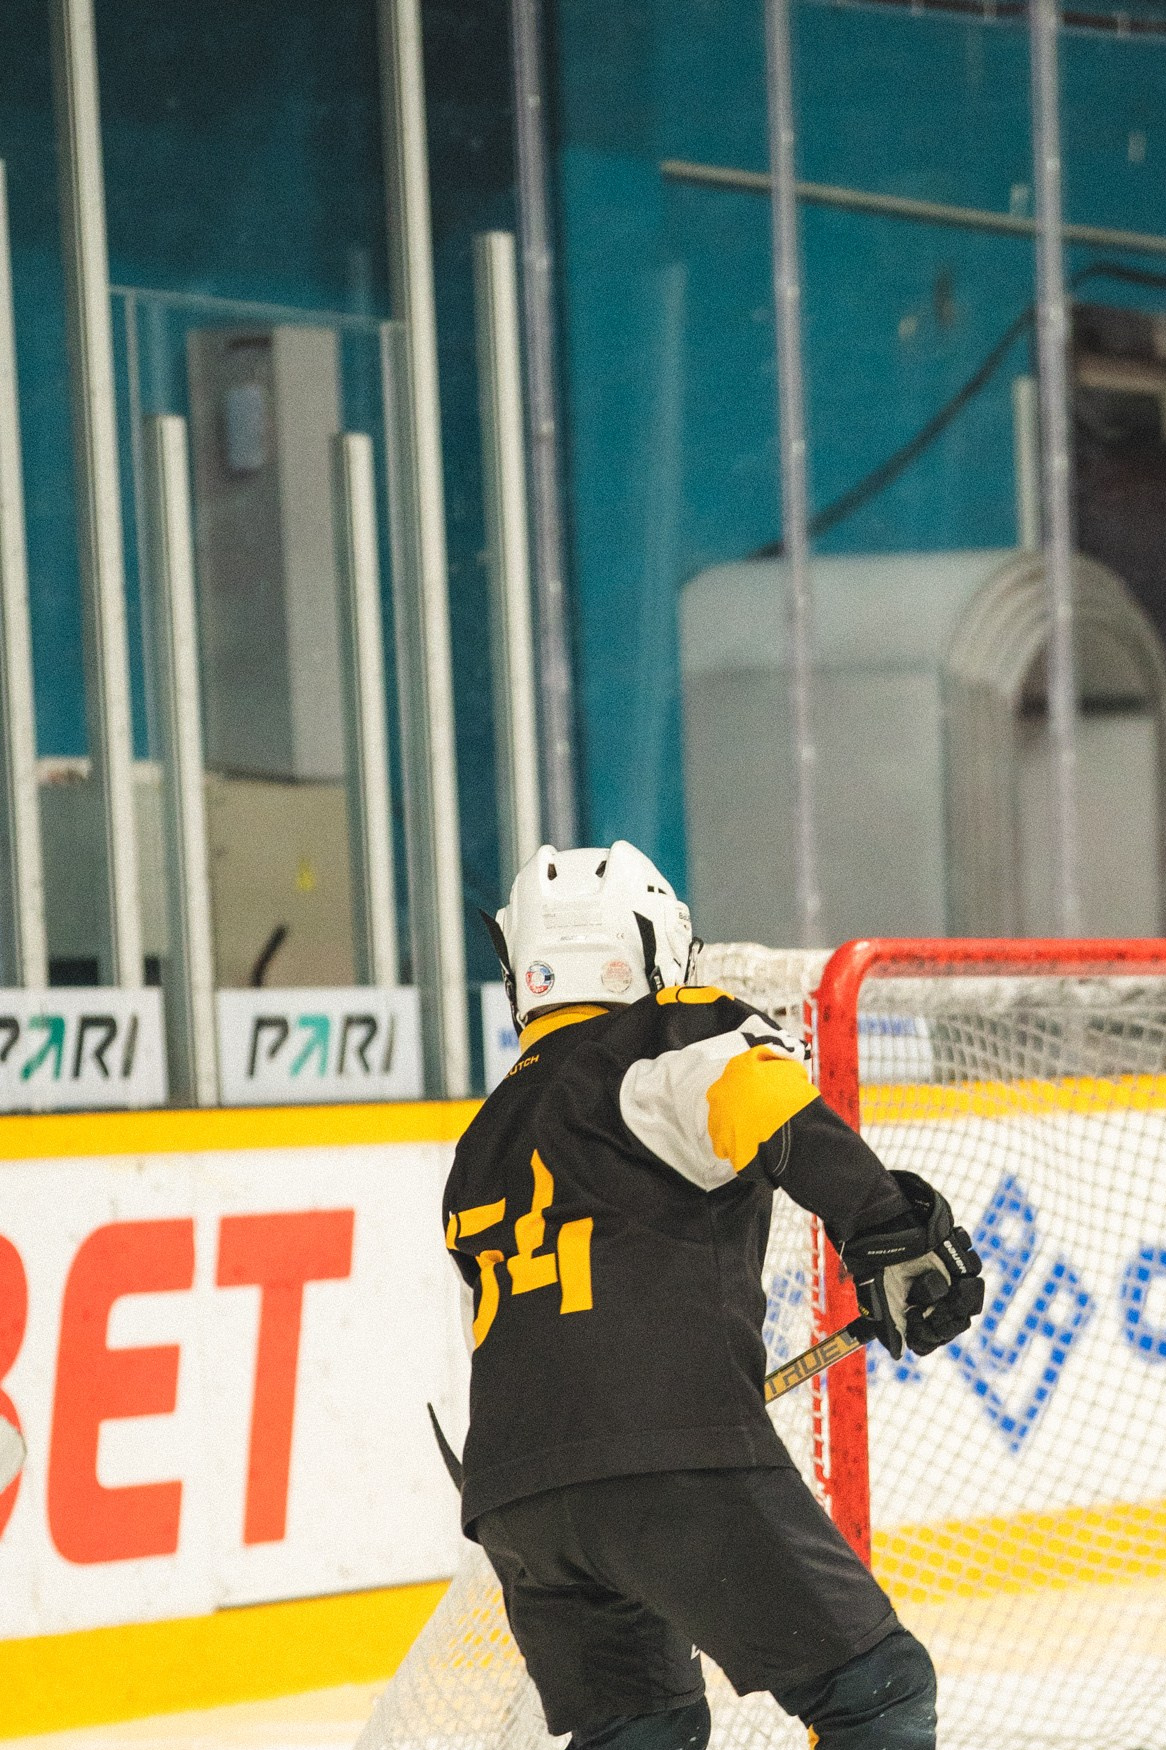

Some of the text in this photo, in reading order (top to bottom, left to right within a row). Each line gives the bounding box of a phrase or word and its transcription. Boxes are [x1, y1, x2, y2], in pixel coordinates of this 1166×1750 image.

[247, 1013, 395, 1079] PARI
[446, 1148, 594, 1352] 54
[0, 1208, 356, 1567] ET
[765, 1337, 840, 1395] TRUE
